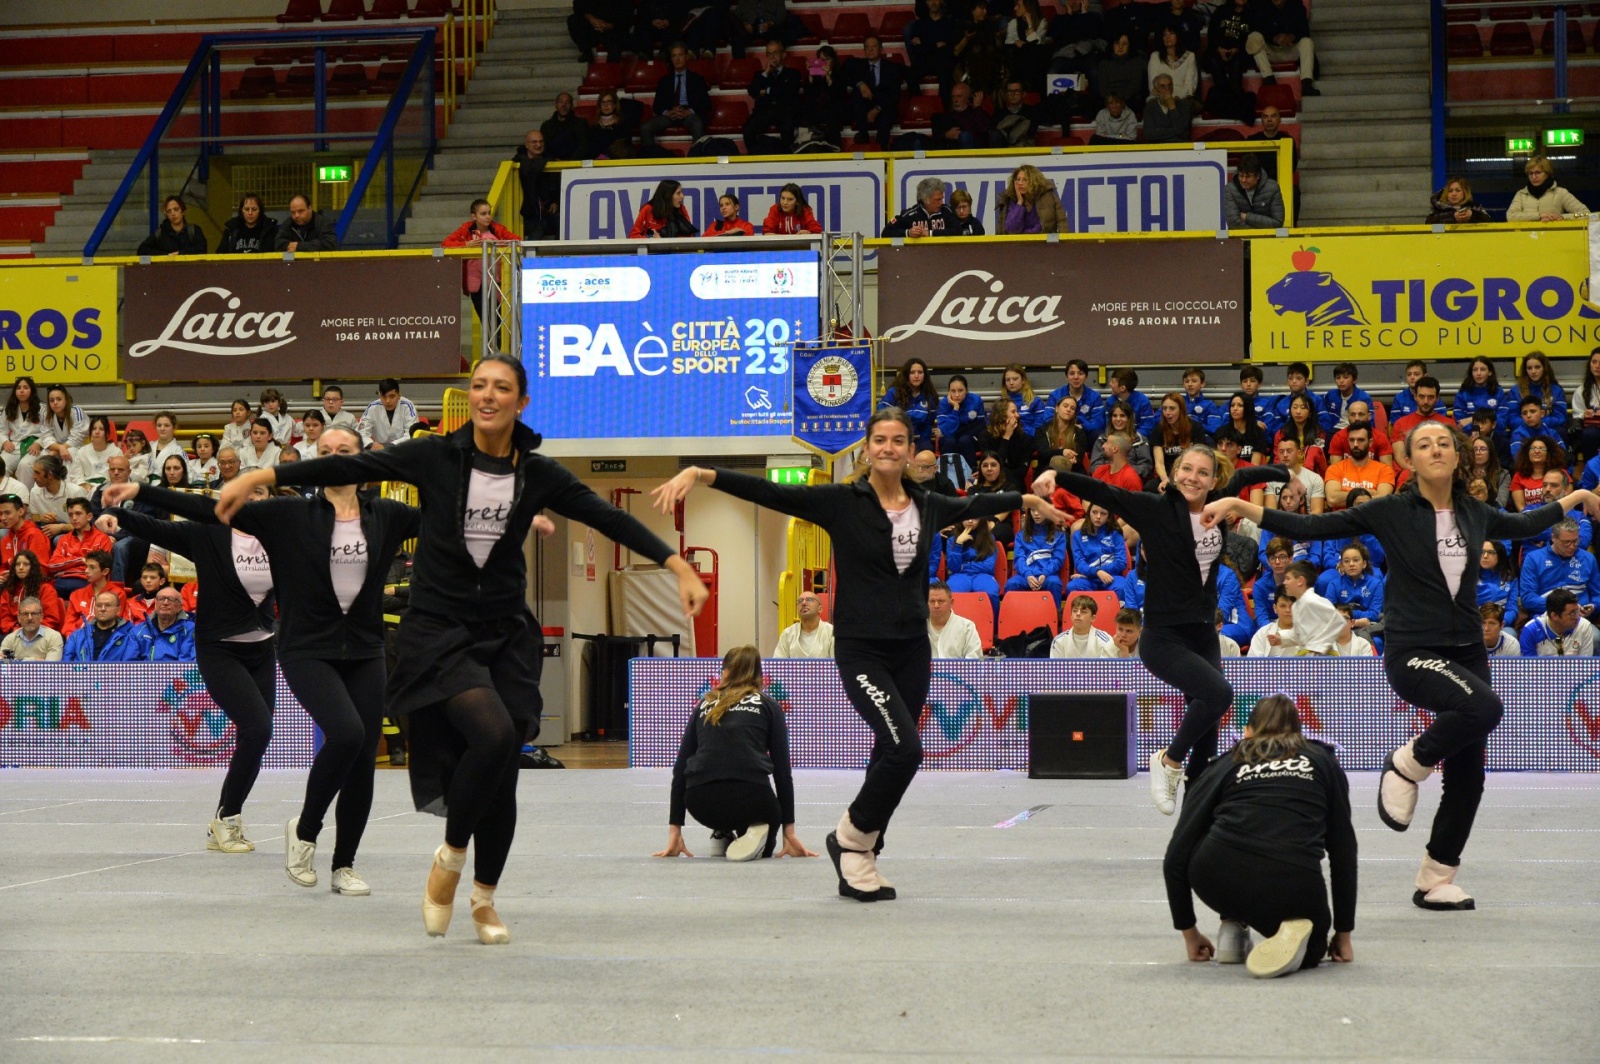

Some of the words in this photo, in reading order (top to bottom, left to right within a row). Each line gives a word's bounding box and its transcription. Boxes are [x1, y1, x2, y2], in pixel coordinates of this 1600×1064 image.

[542, 278, 567, 287] aces
[584, 277, 610, 286] aces
[881, 269, 1065, 342] Laica
[1090, 302, 1128, 312] AMORE
[1130, 301, 1149, 311] PER
[1152, 301, 1162, 311] IL
[1164, 300, 1238, 311] CIOCCOLATO
[129, 287, 297, 357] Laica
[320, 318, 355, 328] AMORE
[357, 317, 375, 327] PER
[377, 317, 387, 326] IL
[388, 315, 456, 326] CIOCCOLATO
[1106, 317, 1134, 326] 1946
[1138, 316, 1178, 326] ARONA
[1182, 315, 1221, 325] ITALIA
[335, 332, 360, 342] 1946
[364, 331, 401, 341] ARONA
[404, 330, 441, 340] ITALIA
[671, 316, 741, 340] CITTÀ
[744, 318, 790, 347] 20
[1271, 331, 1290, 349] IL
[1306, 328, 1418, 348] FRESCO
[1439, 323, 1482, 345] PIÙ
[671, 340, 741, 352] EUROPEA
[6, 353, 101, 372] BUONO
[671, 356, 741, 375] SPORT
[745, 346, 790, 375] 23
[236, 552, 270, 565] aret
